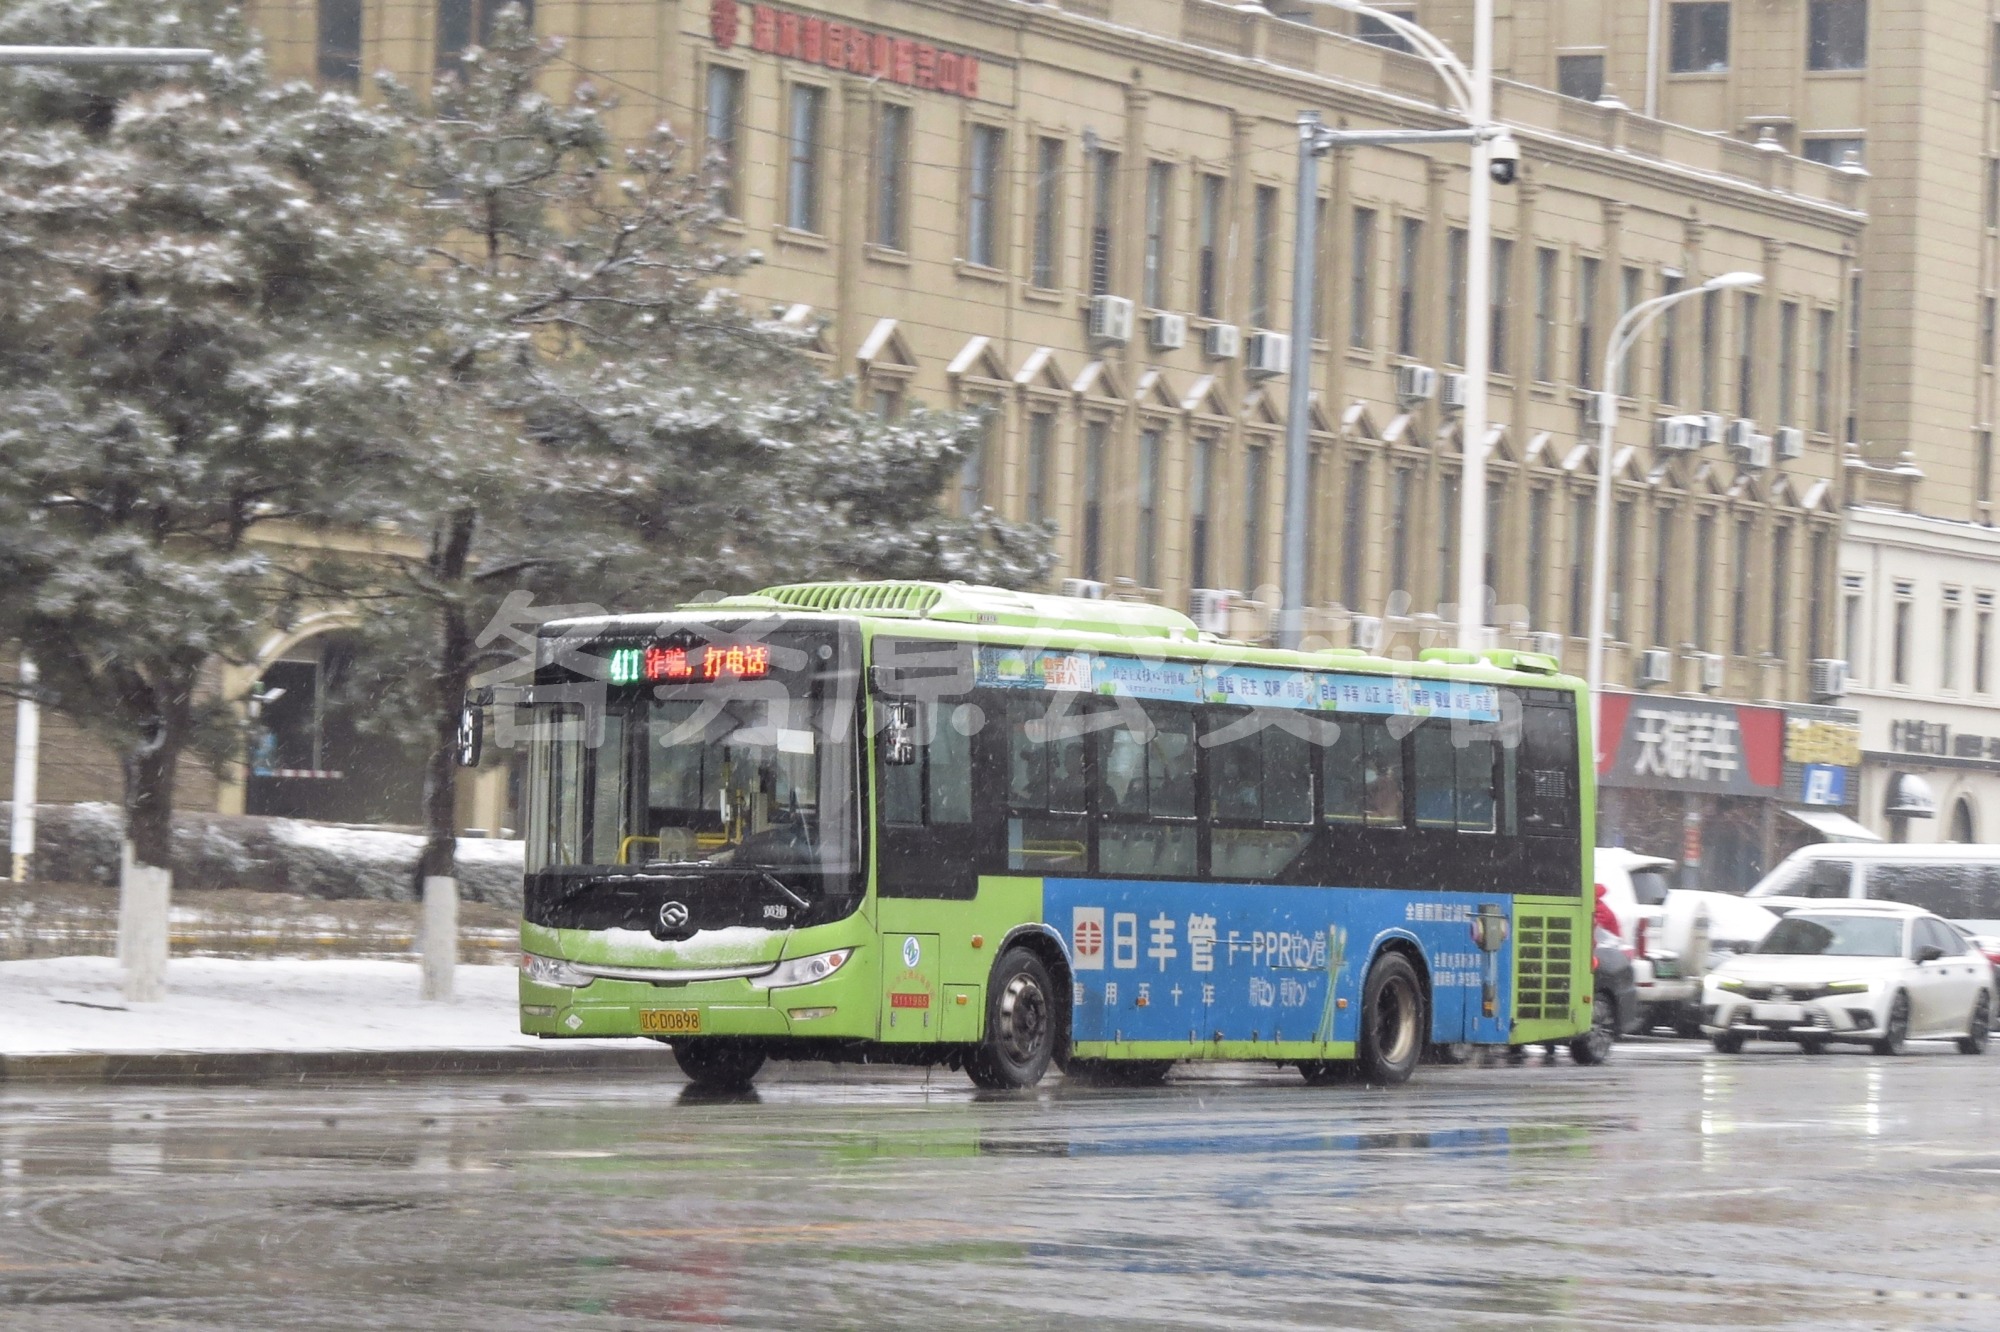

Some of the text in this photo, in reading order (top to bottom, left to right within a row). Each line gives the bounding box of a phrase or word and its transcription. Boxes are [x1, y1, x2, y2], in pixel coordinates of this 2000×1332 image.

[610, 649, 639, 680] 411
[1240, 678, 1258, 696] 民主
[1321, 684, 1338, 701] 自由
[1342, 685, 1360, 703] 平等
[1364, 687, 1381, 704] 公正
[1113, 911, 1217, 972] 日丰管
